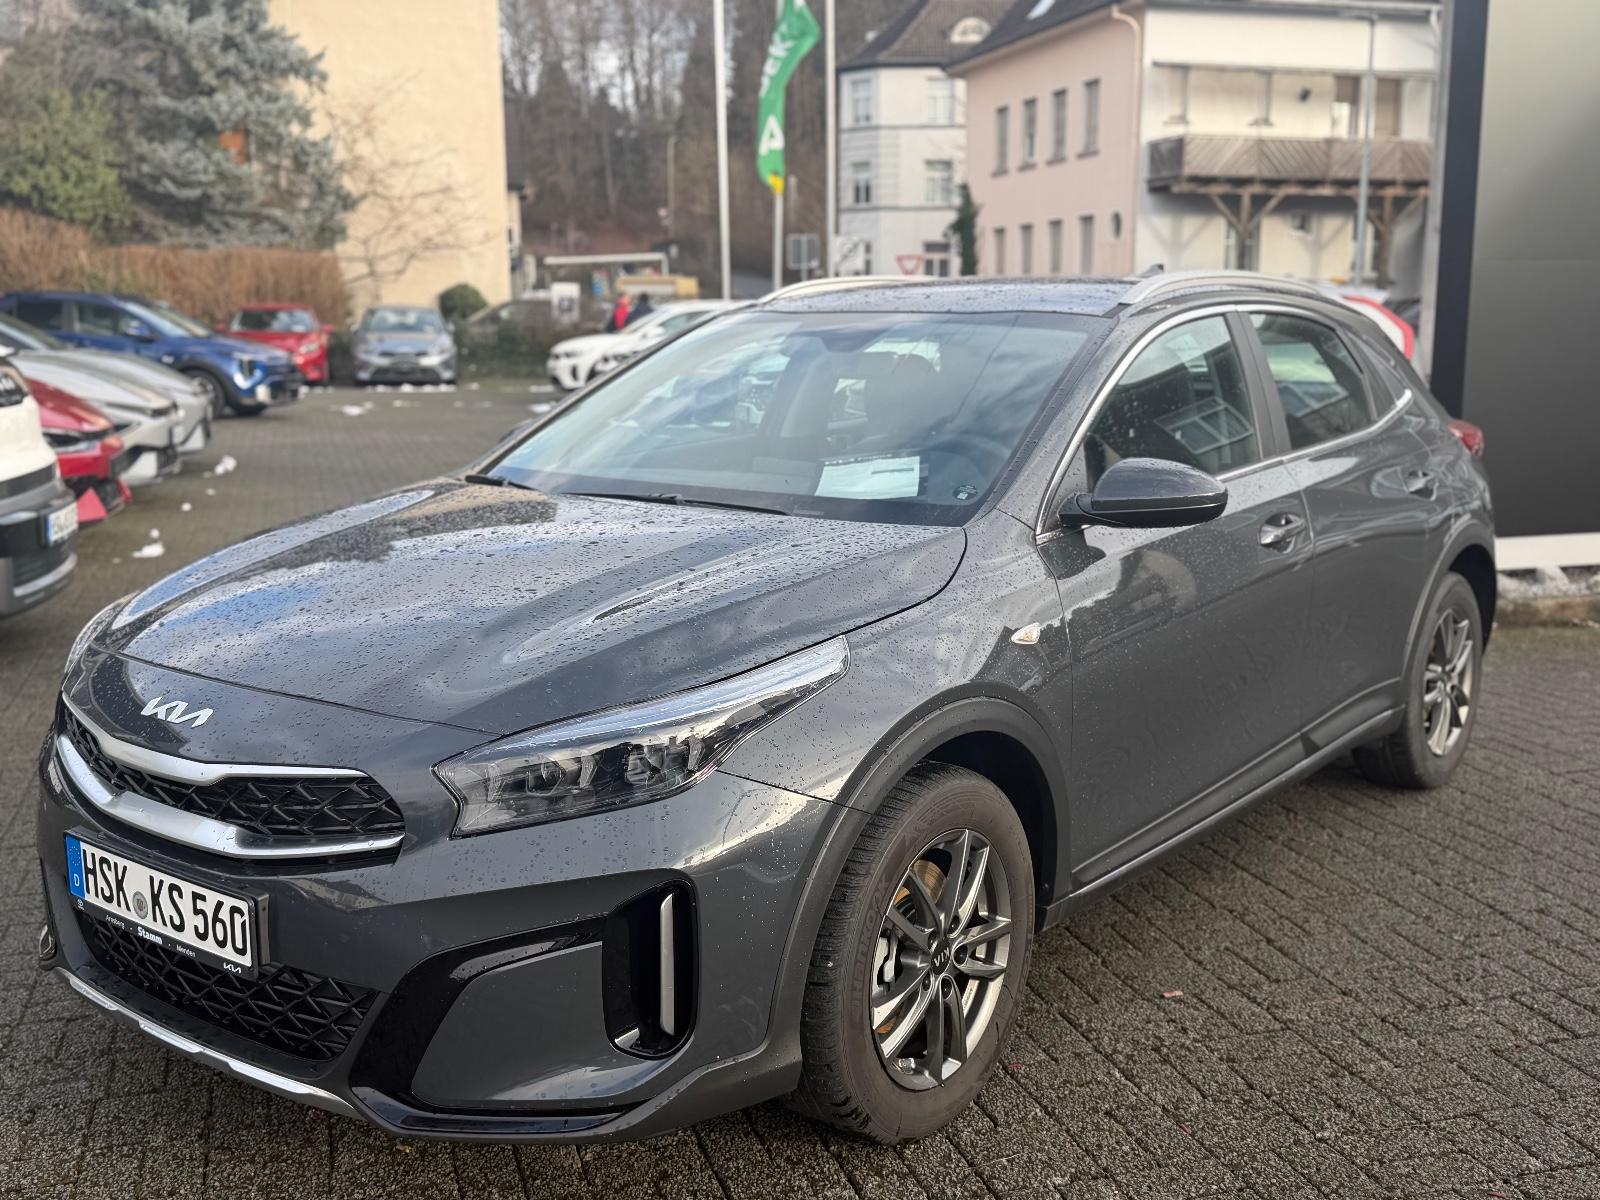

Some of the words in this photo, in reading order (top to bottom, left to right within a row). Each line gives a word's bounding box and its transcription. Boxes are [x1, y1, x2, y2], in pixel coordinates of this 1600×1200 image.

[141, 696, 214, 728] KIA
[73, 873, 80, 887] D
[82, 848, 132, 912] HSK
[149, 875, 186, 933] KS
[191, 890, 248, 957] 560
[137, 926, 163, 945] Stamm
[933, 946, 950, 968] KIA
[223, 961, 242, 974] KIA
